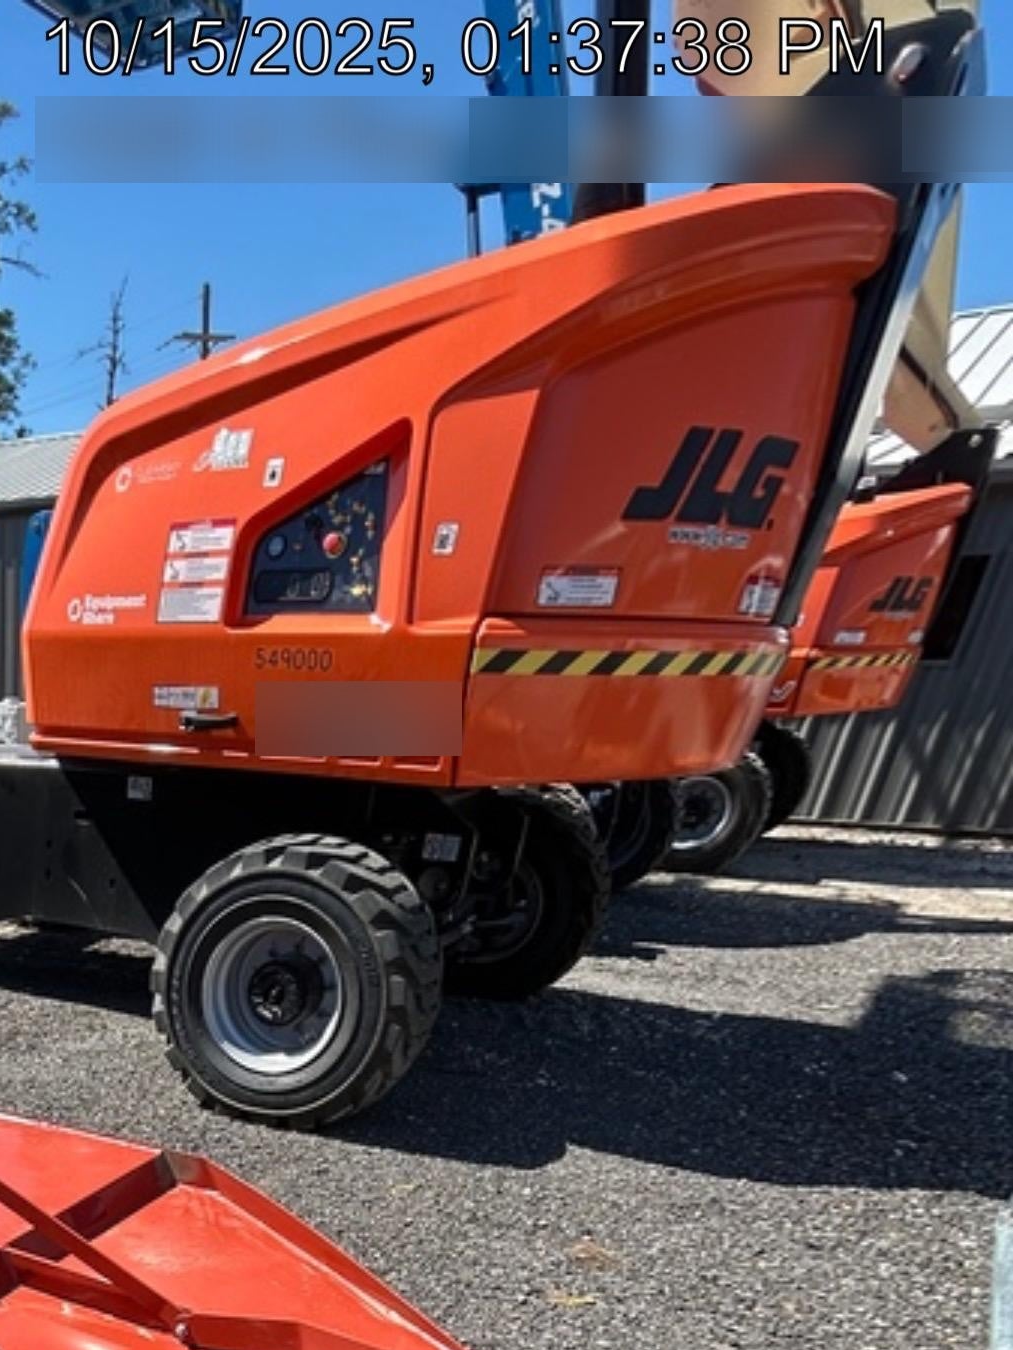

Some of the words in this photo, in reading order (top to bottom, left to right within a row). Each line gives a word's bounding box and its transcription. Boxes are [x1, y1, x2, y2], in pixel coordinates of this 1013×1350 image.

[621, 425, 800, 530] JLG
[867, 575, 935, 612] JLG
[253, 647, 333, 673] 549000
